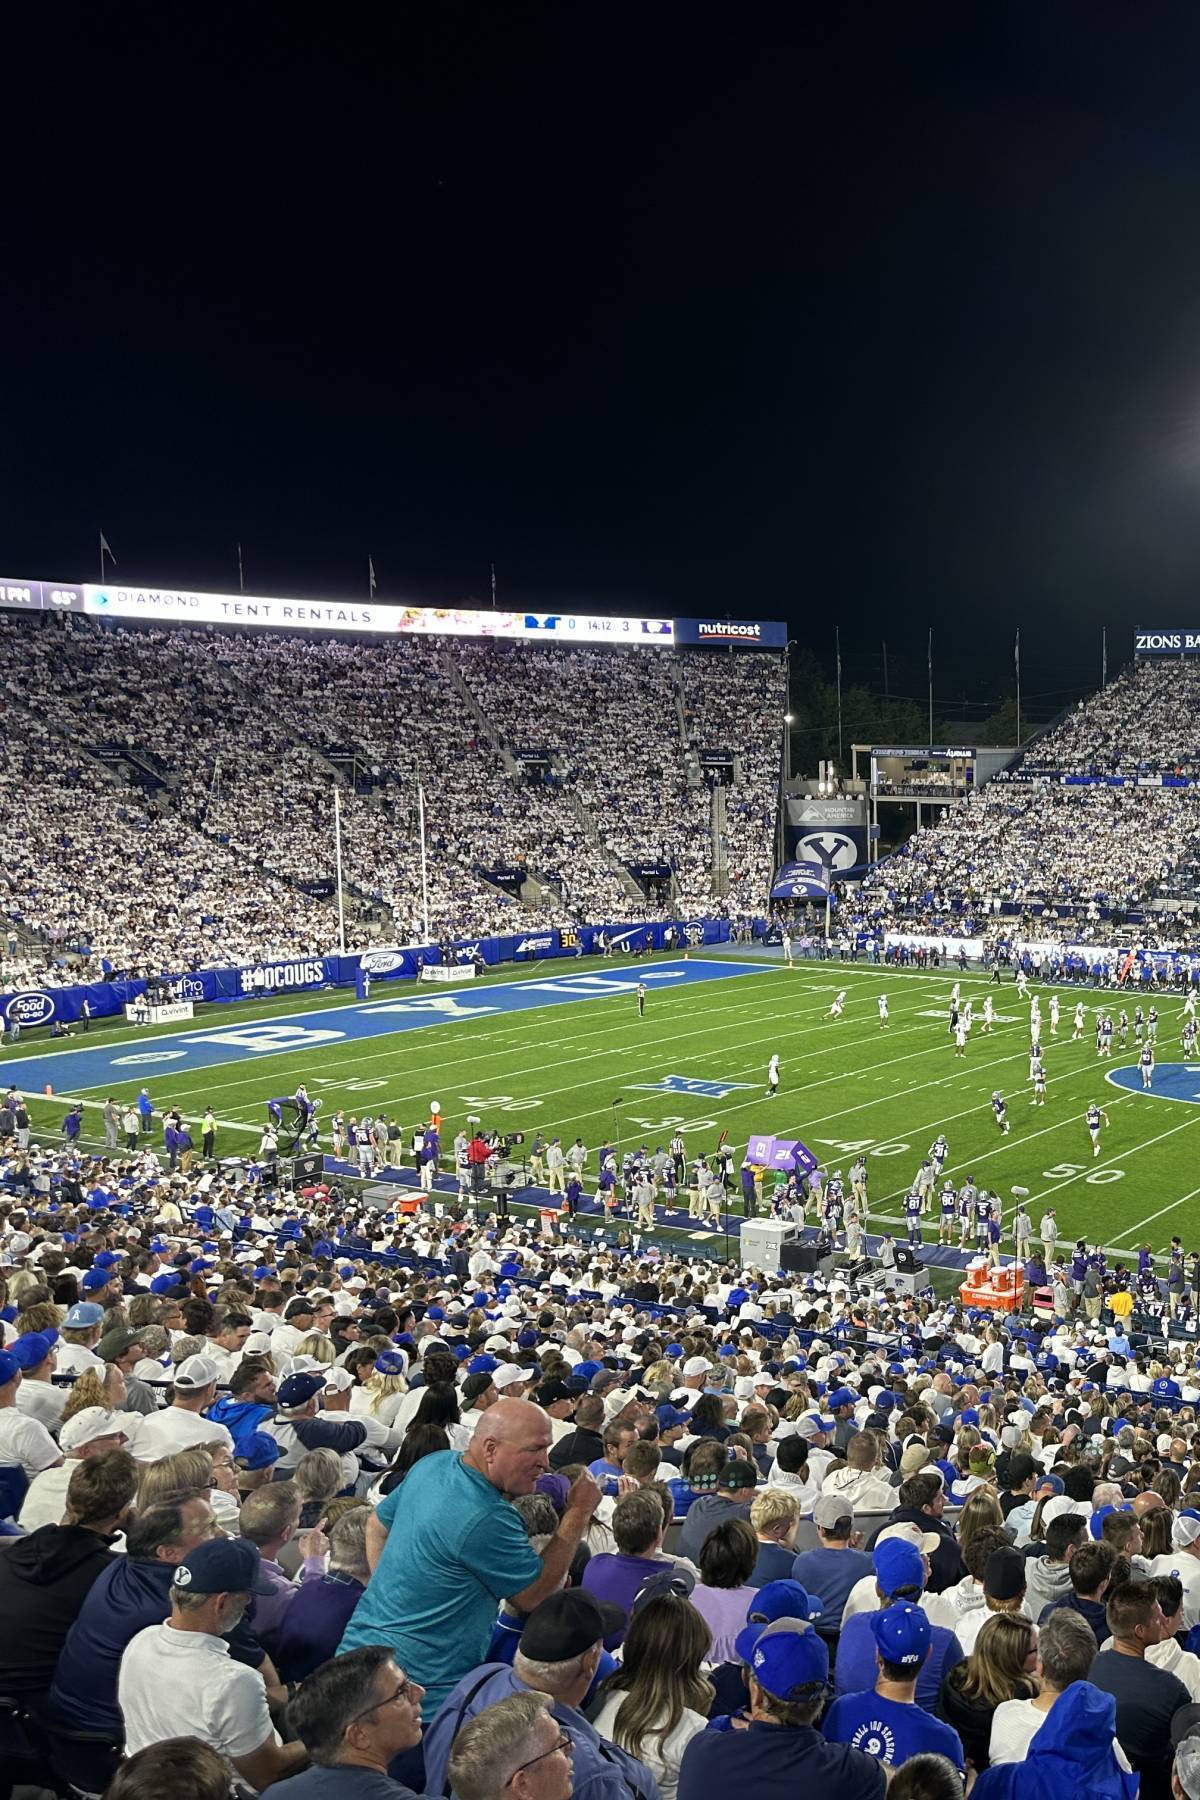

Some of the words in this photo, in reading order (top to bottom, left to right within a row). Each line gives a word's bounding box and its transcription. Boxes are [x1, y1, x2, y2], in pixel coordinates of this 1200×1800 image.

[117, 591, 200, 607] DIAMOND
[221, 601, 271, 617] TENT
[283, 606, 372, 623] RENTALS
[568, 618, 575, 630] 0
[622, 620, 630, 632] 3
[698, 622, 761, 637] nutricost
[1136, 633, 1181, 650] ZIONS
[561, 934, 576, 948] 30
[369, 956, 396, 971] Ford
[240, 960, 324, 993] #OCOUGS
[17, 998, 45, 1012] Food
[1041, 1162, 1127, 1184] 50
[908, 1199, 920, 1210] 81
[942, 1195, 954, 1207] 80
[978, 1205, 987, 1216] 5
[176, 1567, 189, 1584] Y
[900, 1654, 919, 1664] BYU
[851, 1723, 869, 1749] TBALL
[880, 1726, 896, 1765] SEASONS
